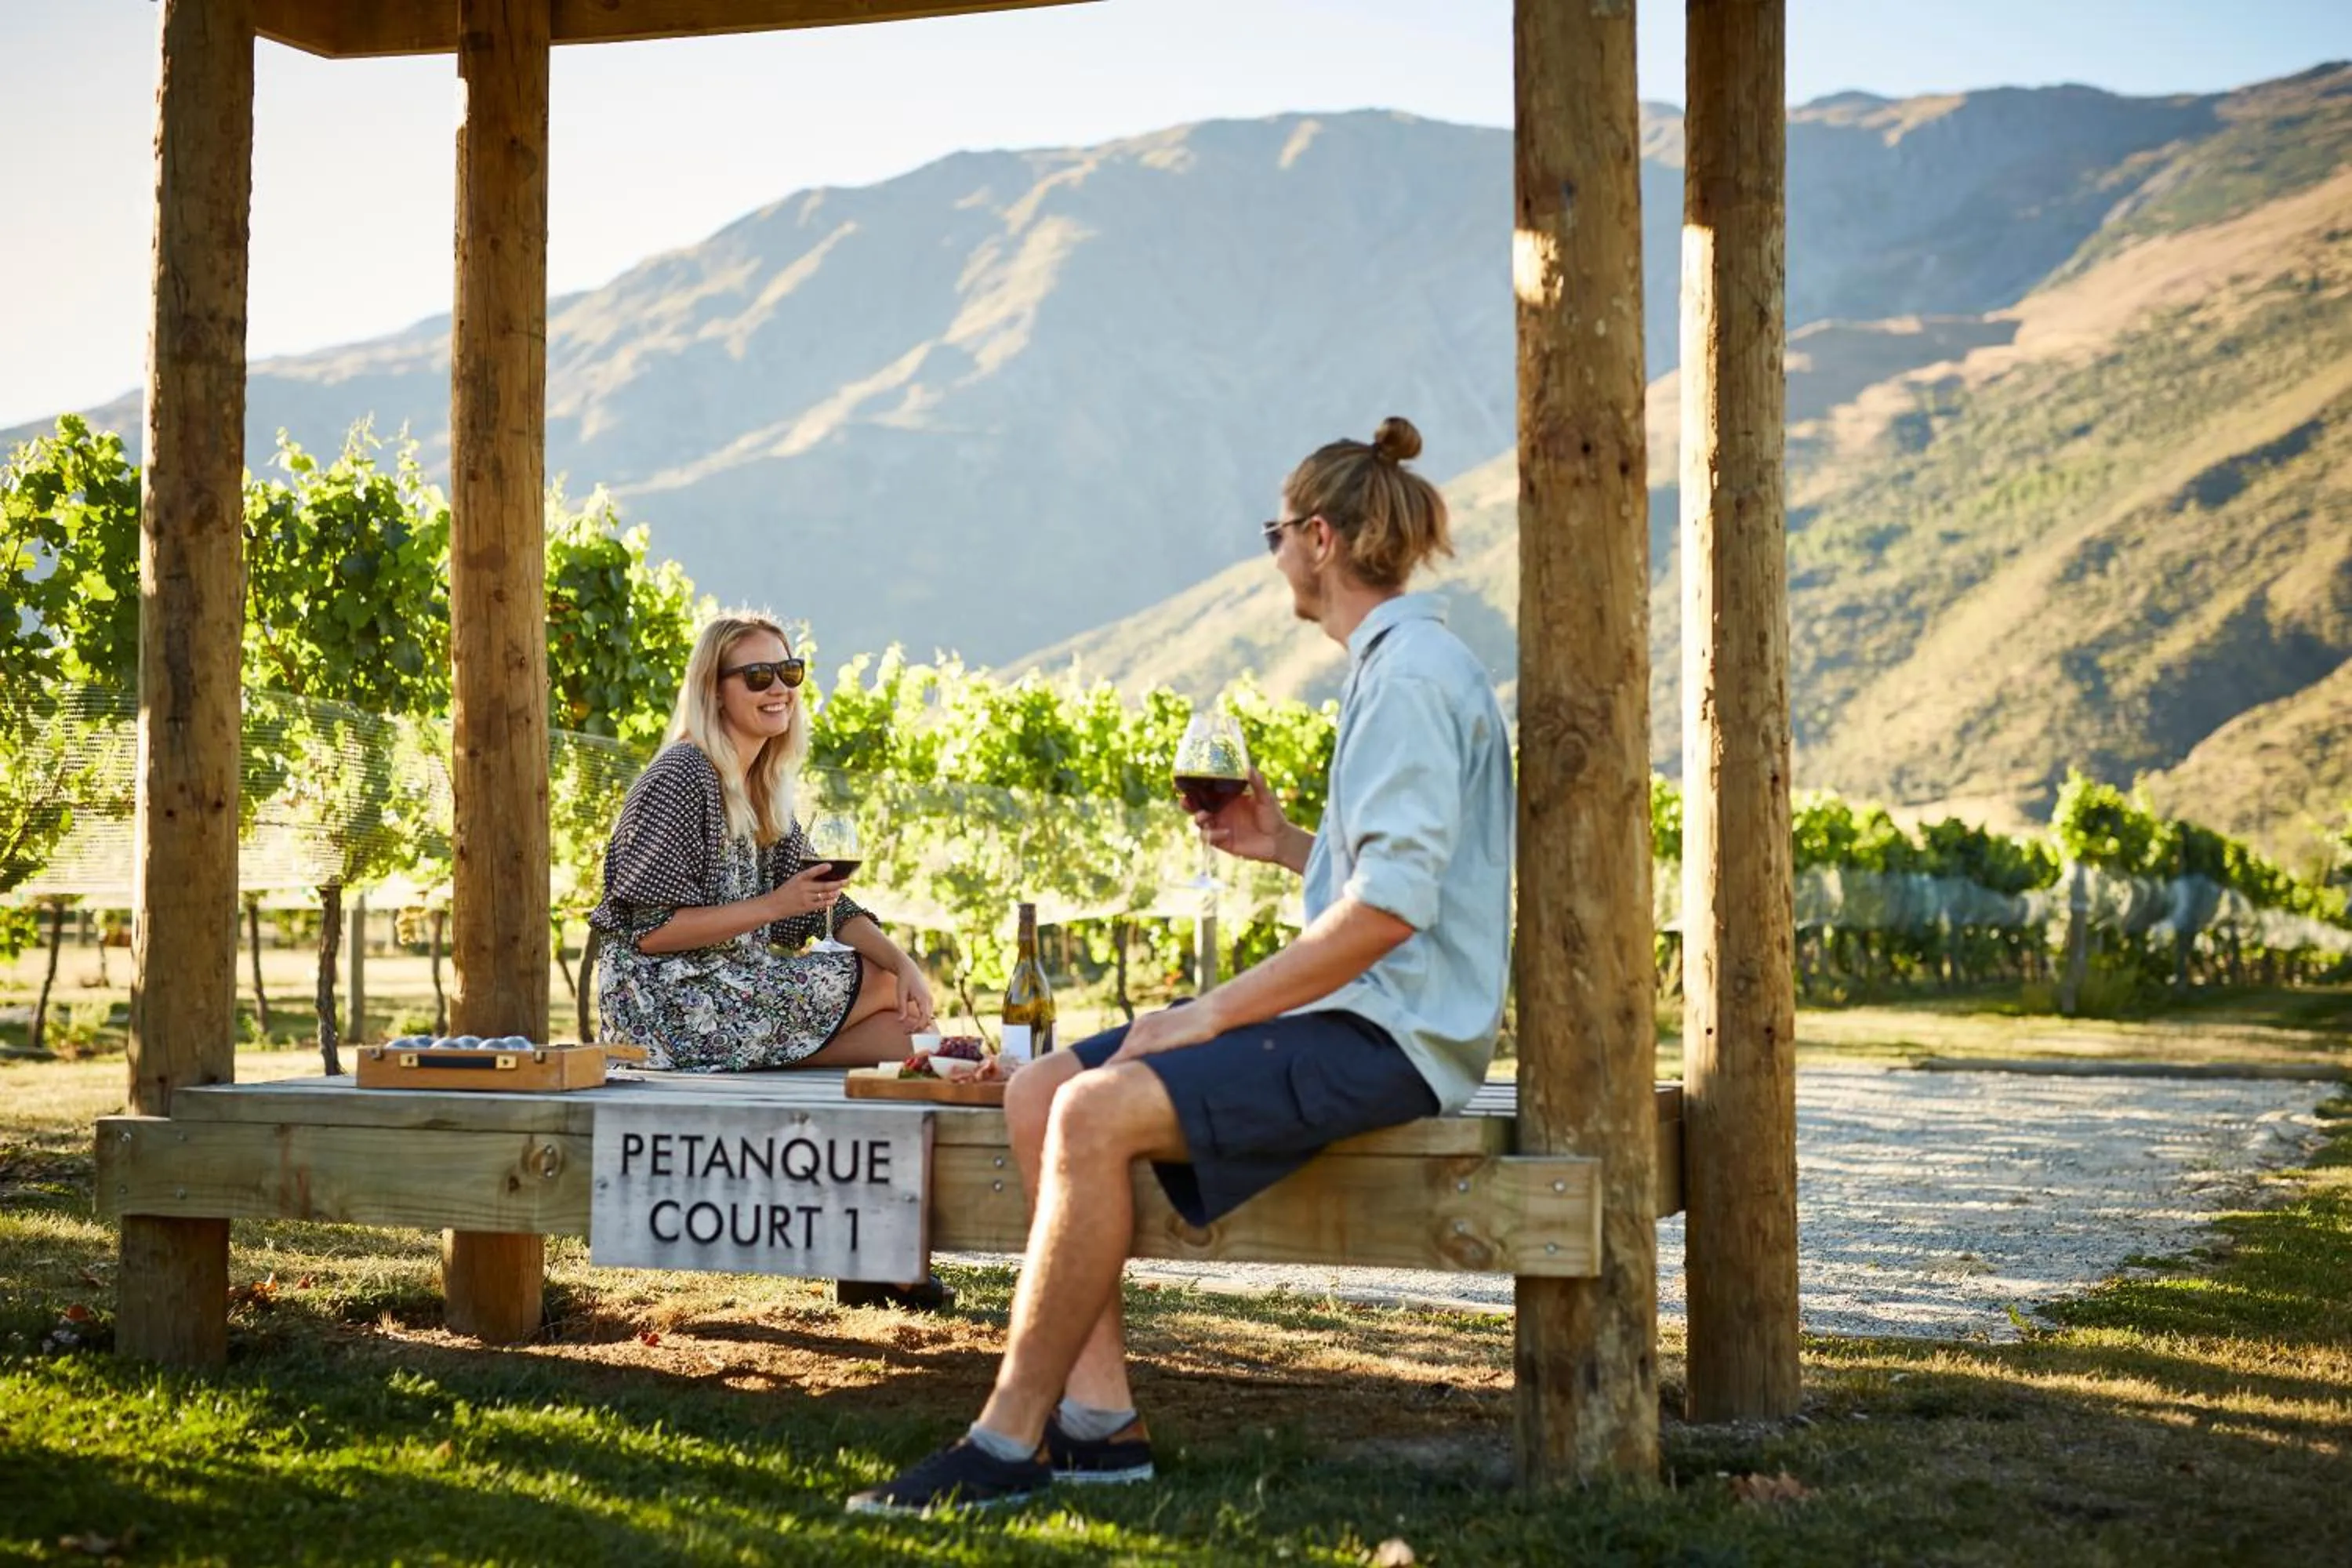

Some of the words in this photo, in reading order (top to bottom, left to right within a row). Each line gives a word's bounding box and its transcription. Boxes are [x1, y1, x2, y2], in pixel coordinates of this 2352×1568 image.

[621, 1133, 890, 1185] PETANQUE
[650, 1200, 822, 1248] COURT
[845, 1208, 859, 1251] 1
